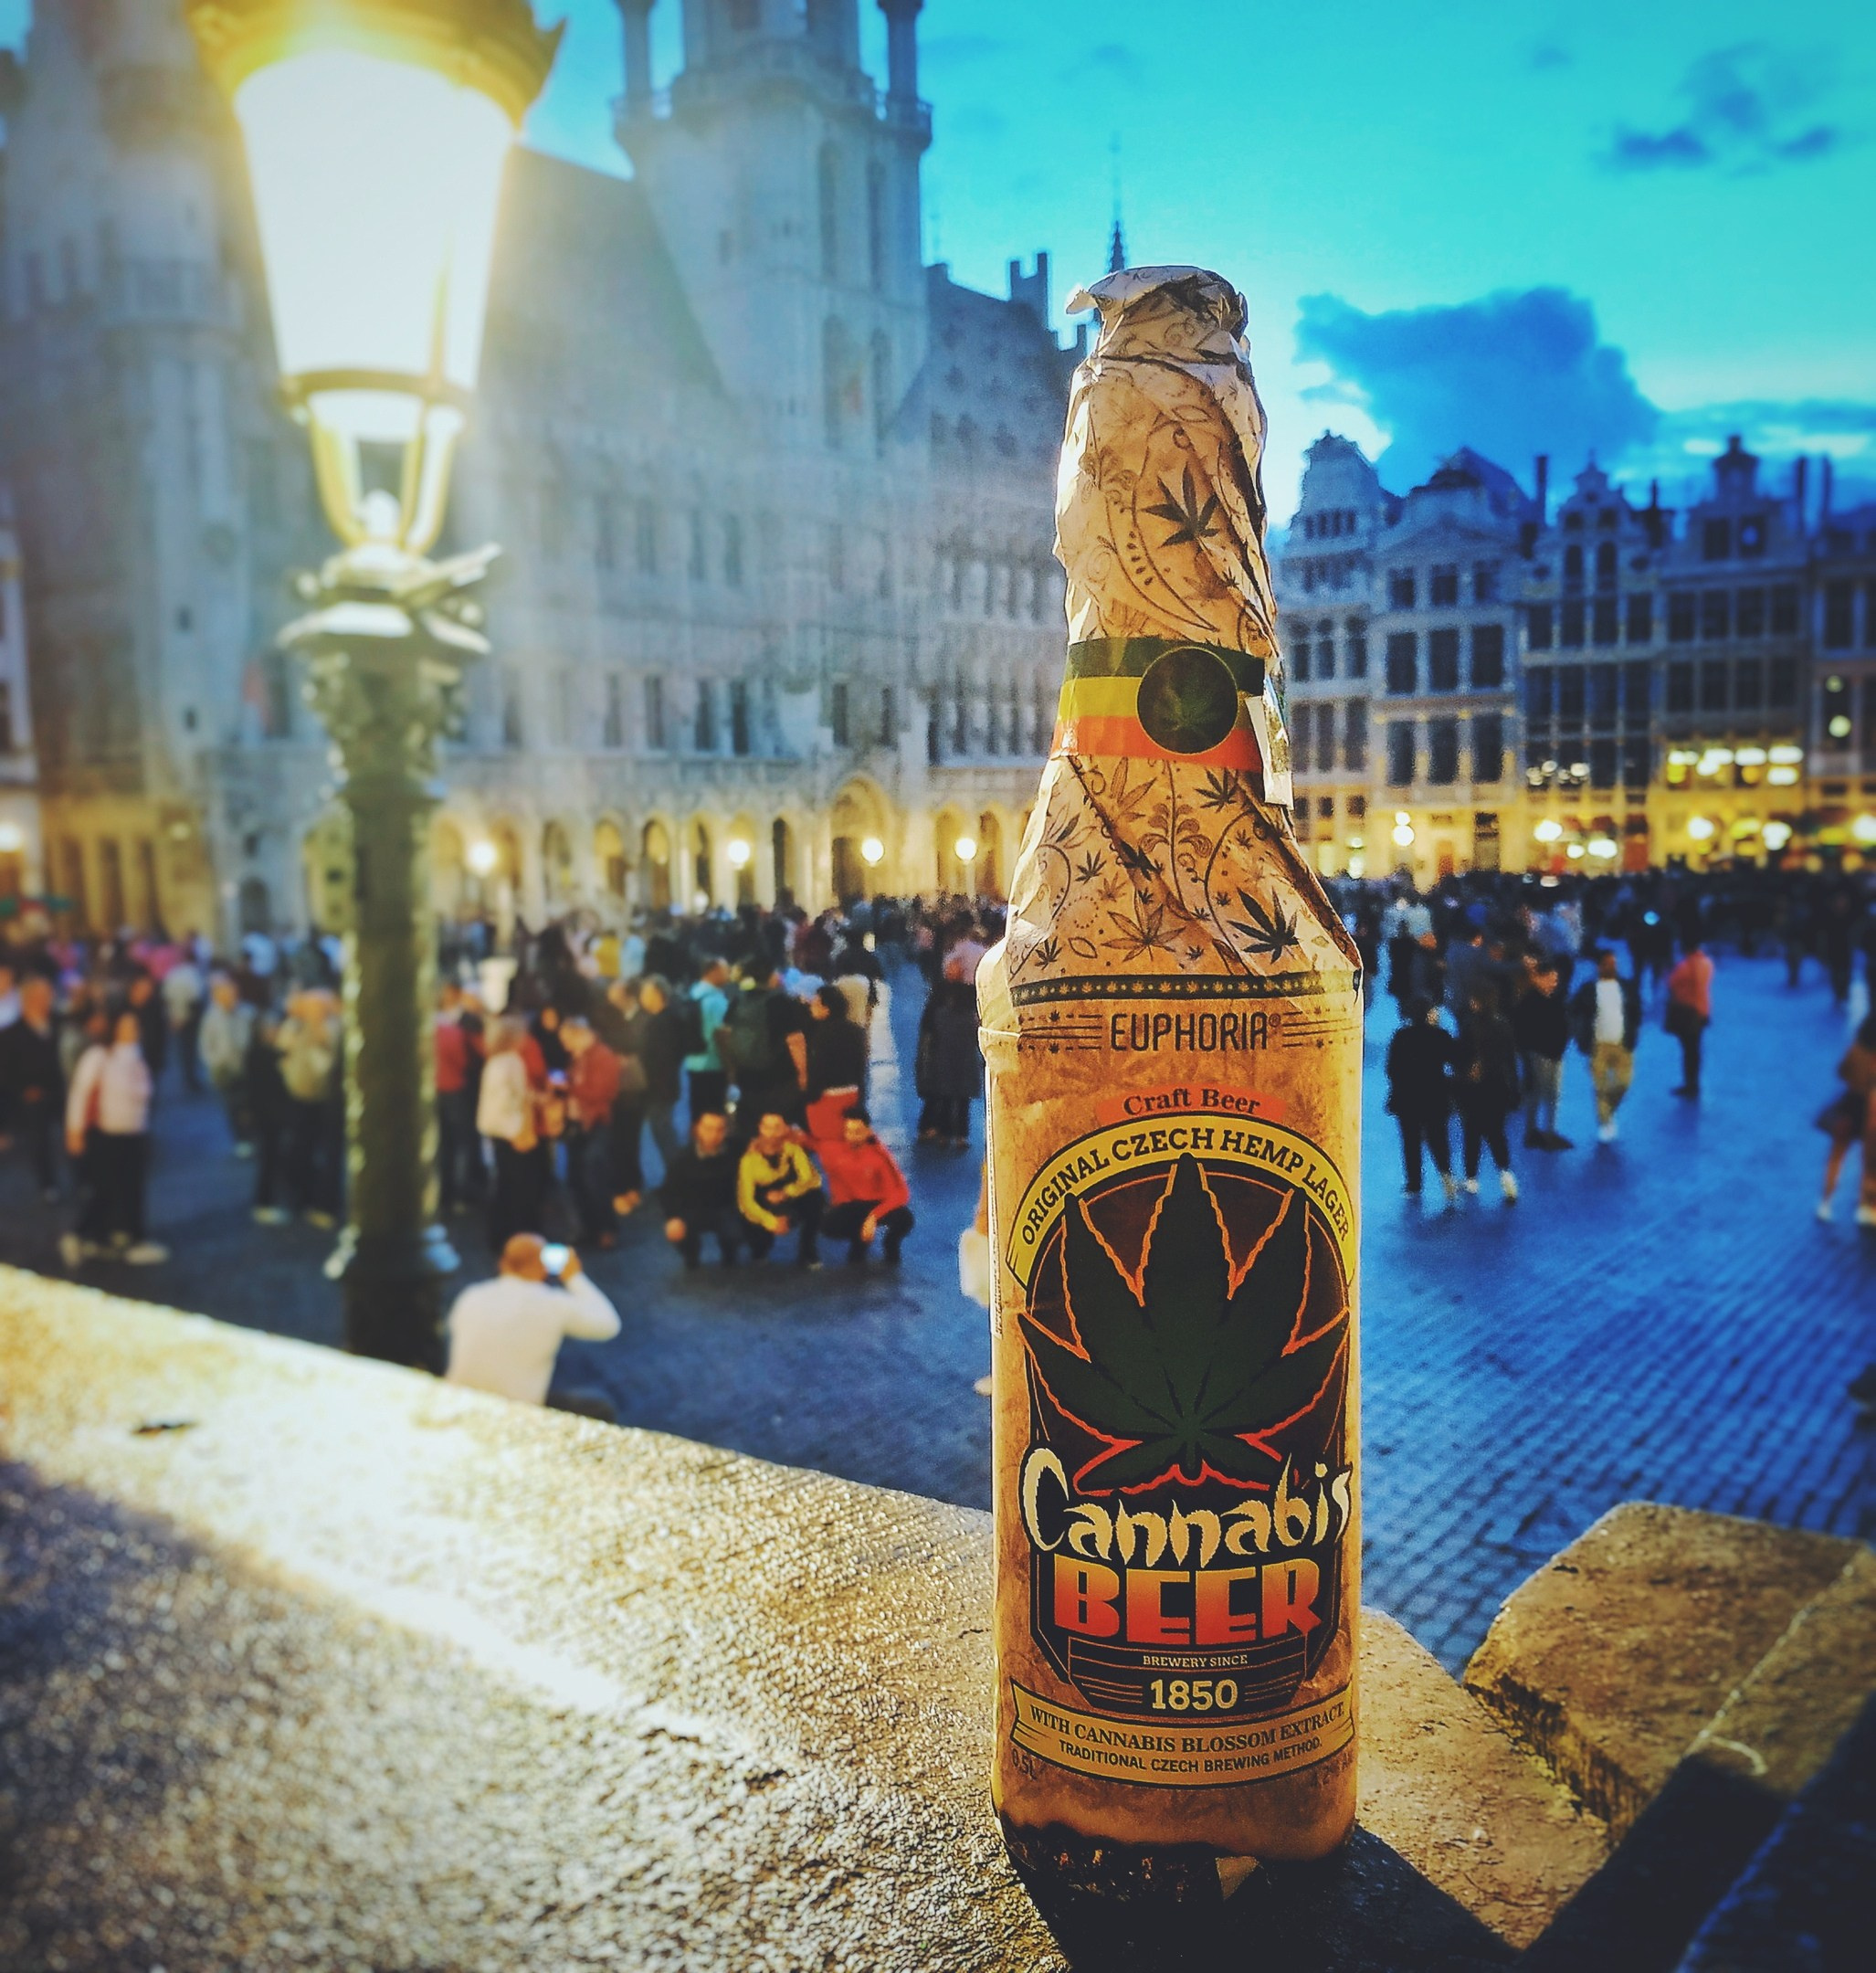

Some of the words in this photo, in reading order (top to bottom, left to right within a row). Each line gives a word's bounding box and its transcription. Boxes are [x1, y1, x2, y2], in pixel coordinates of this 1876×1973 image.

[1123, 1088, 1192, 1115] Craft
[1200, 1088, 1260, 1114] Beer
[1022, 1149, 1110, 1245] ORIGINAL
[1112, 1127, 1215, 1161] CZECH
[1220, 1129, 1303, 1174] HEMP
[1302, 1165, 1351, 1242] LAGER
[1022, 1447, 1353, 1567] Cannabis
[1054, 1553, 1323, 1645] BEER
[1143, 1655, 1207, 1668] BREWERY
[1209, 1654, 1249, 1667] SINCE
[1151, 1679, 1238, 1711] 1850
[1029, 1704, 1071, 1736] WITH
[1074, 1723, 1175, 1753] CANNABIS
[1181, 1728, 1276, 1753] BLOSSOM
[1059, 1738, 1147, 1770] TRADITIONAL
[1151, 1757, 1198, 1773] CZECH
[1204, 1752, 1270, 1772] BREWING
